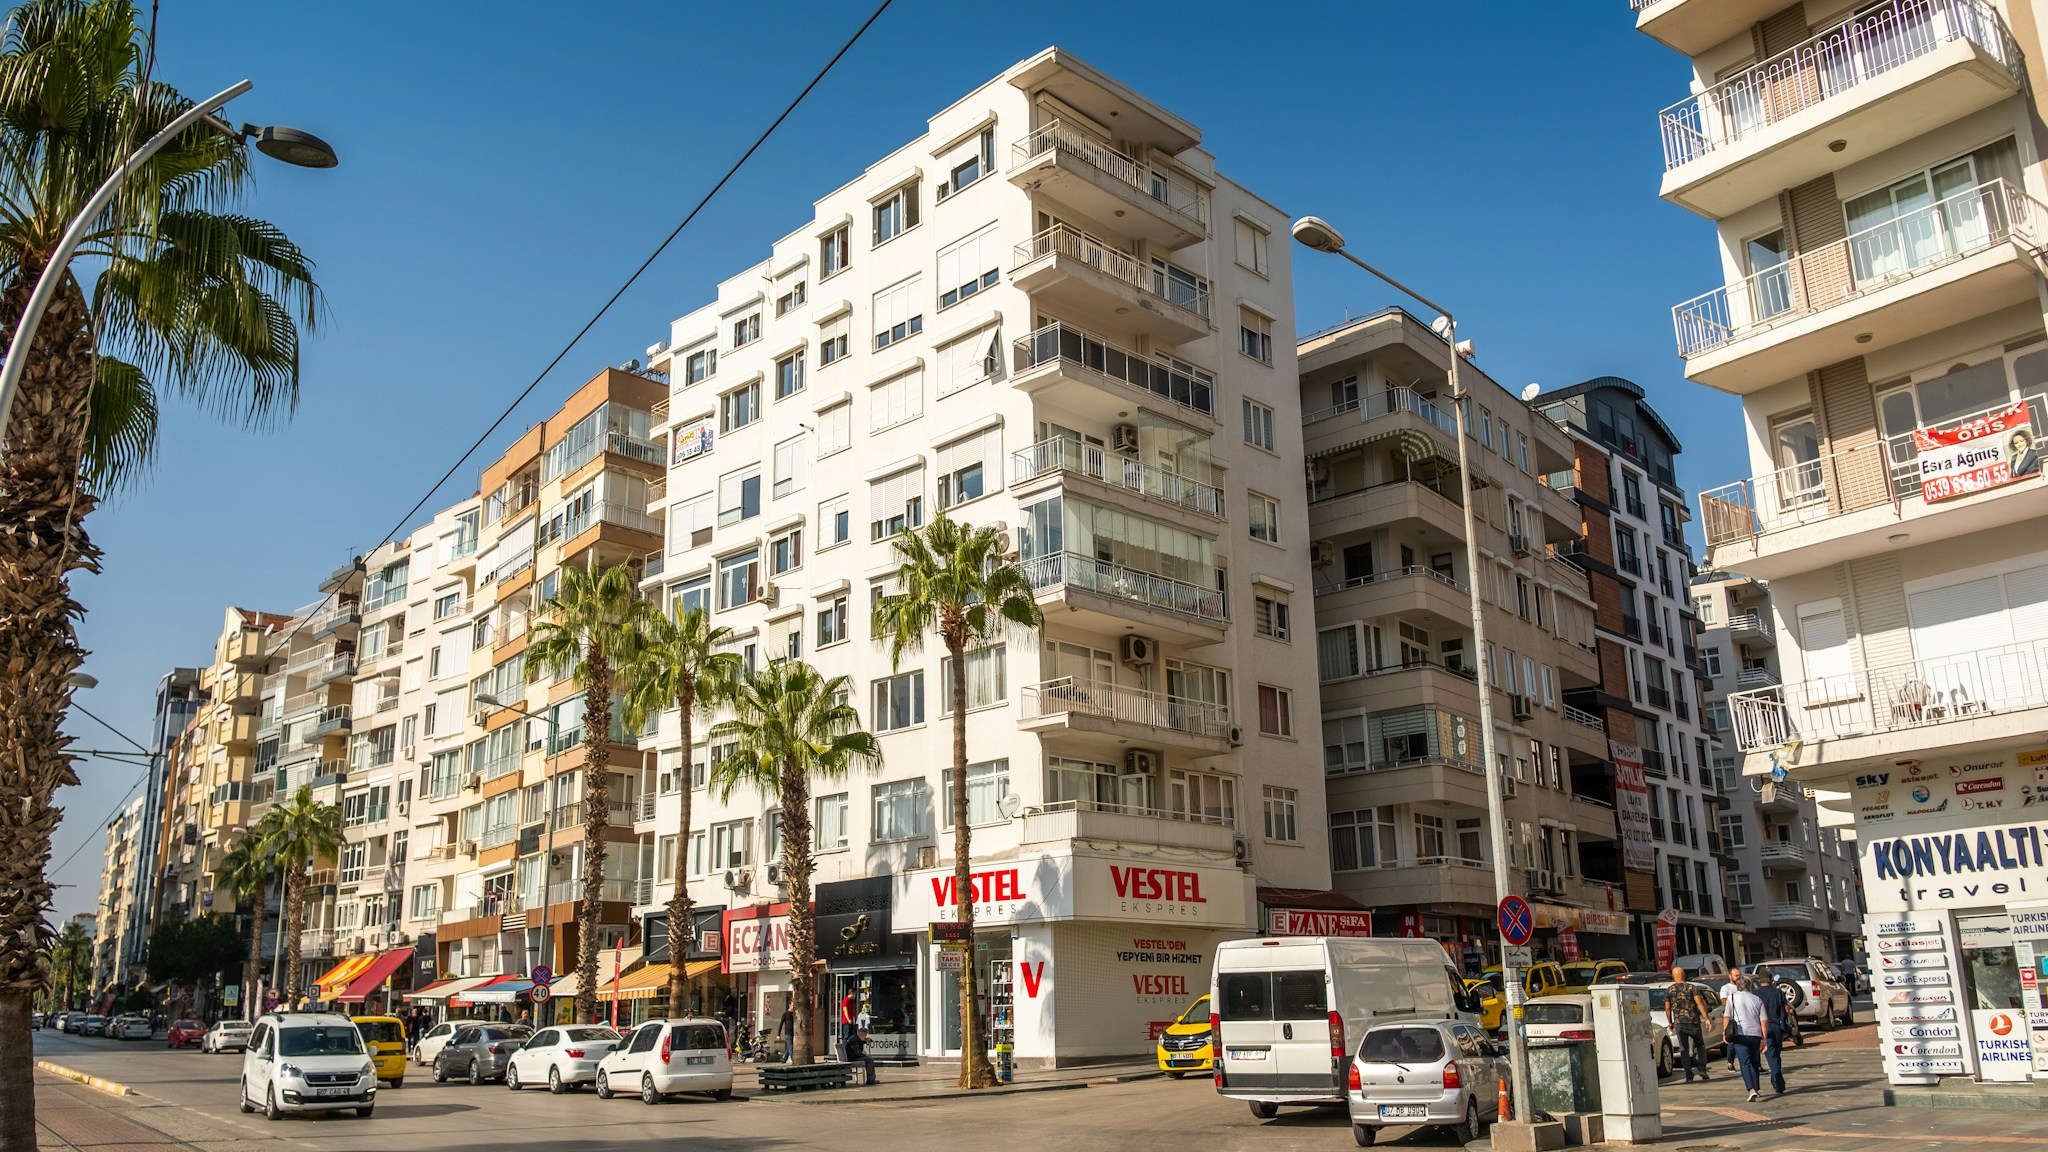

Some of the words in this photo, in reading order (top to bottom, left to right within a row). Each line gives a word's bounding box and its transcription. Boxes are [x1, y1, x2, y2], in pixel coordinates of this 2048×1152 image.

[1958, 421, 2005, 441] OFİS
[1922, 459, 1952, 474] Esra
[1957, 447, 1999, 467] Ağmış
[1925, 477, 1950, 501] 0539
[1976, 469, 1991, 488] 60
[1993, 465, 2008, 483] 55
[1963, 761, 2004, 772] Onurair
[1967, 779, 2002, 791] Corendon
[1863, 812, 1895, 820] AEROFLOT
[1873, 826, 2043, 881] KONYAALTI
[1110, 865, 1207, 903] VESTEL
[1899, 877, 2027, 901] travel
[940, 903, 1017, 920] EKPRES
[1121, 901, 1198, 916] EKSPRES
[1274, 911, 1338, 937] ECZANE
[1586, 911, 1609, 926] BİRSEN
[732, 921, 789, 955] ECZAN
[1133, 938, 1186, 950] VESTEL'DEN
[1894, 939, 1940, 947] atlasjet
[753, 957, 776, 968] DOĞUŞ
[1116, 951, 1155, 962] YEPYENİ
[1156, 952, 1170, 963] BİR
[1172, 953, 1202, 964] HİZMET
[1020, 961, 1045, 998] V
[1132, 974, 1190, 995] VESTEL
[1897, 975, 1946, 984] SunExpress
[533, 988, 547, 998] 40
[1136, 996, 1186, 1004] EKSPRES
[1909, 1027, 1953, 1037] Condor
[1910, 1046, 1957, 1054] Corendon
[1978, 1040, 2029, 1050] TURKISH
[1981, 1051, 2033, 1062] AIRLINES
[1386, 1106, 1393, 1114] 07
[1407, 1105, 1424, 1114] 0904
